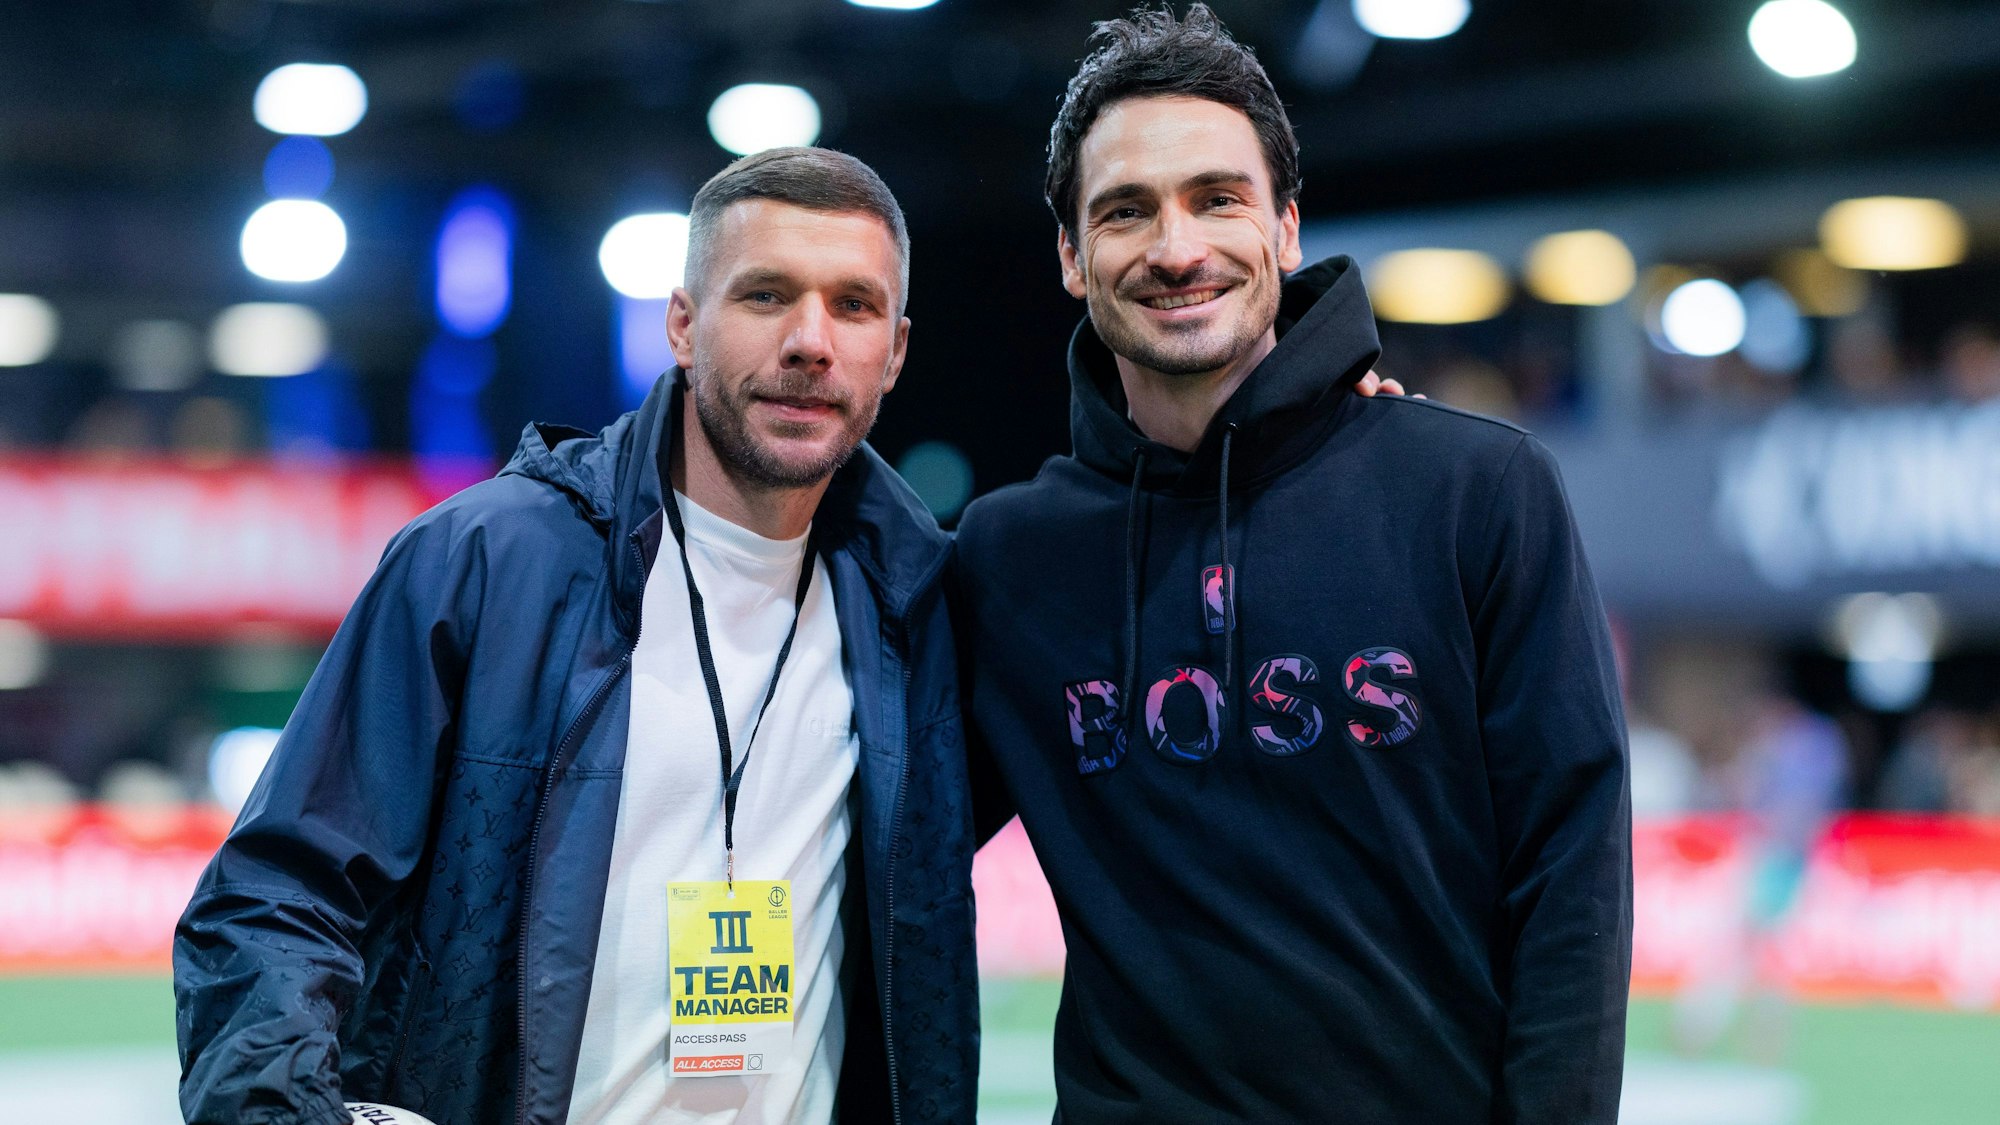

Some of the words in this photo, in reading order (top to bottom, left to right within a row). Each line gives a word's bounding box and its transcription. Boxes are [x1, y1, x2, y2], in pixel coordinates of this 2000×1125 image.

[1062, 645, 1424, 779] BOSS
[1389, 723, 1411, 744] NBA
[708, 910, 754, 954] III
[674, 964, 789, 996] TEAM
[675, 997, 788, 1017] MANAGER
[674, 1034, 718, 1044] ACCESS
[719, 1033, 747, 1043] PASS
[675, 1058, 698, 1070] ALL
[701, 1057, 742, 1069] ACCESS
